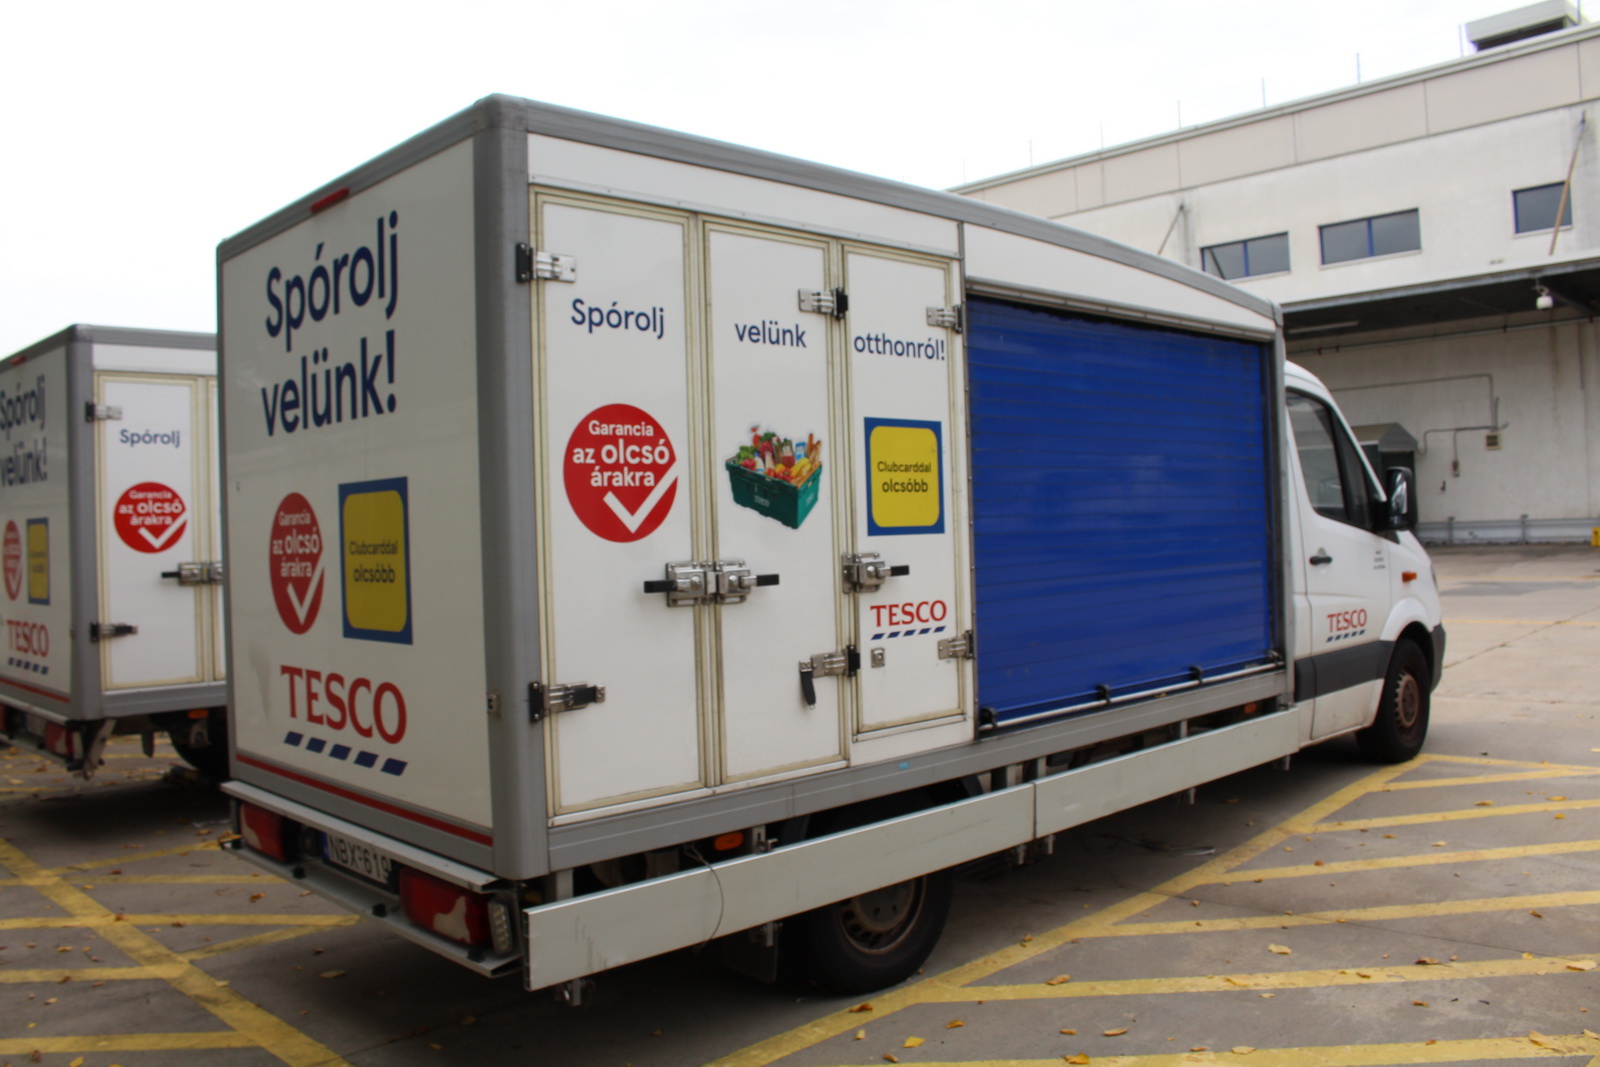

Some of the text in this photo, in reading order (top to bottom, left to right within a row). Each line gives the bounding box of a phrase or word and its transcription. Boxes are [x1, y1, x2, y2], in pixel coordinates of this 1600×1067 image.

[265, 210, 398, 353] Spórolj
[571, 298, 945, 361] Spórolj velünk otthonról!
[261, 329, 397, 437] velünk!
[119, 428, 180, 449] Spórolj
[588, 420, 654, 438] Garancia
[573, 438, 670, 465] az olcsó
[590, 466, 656, 487] árakra
[877, 460, 932, 474] Clubcarddal
[129, 490, 172, 500] Garancia
[882, 478, 929, 494] olcsóbb
[118, 498, 183, 514] az olcsó
[130, 514, 173, 526] árakra
[278, 511, 311, 527] Garancia
[272, 527, 320, 555] az olcsó
[349, 540, 398, 556] Clubcarddal
[280, 556, 313, 579] árakra
[353, 564, 396, 584] olcsóbb
[870, 600, 947, 628] TESCO
[1327, 609, 1368, 633] TESCO
[6, 619, 49, 658] TESCO
[280, 664, 407, 745] TESCO
